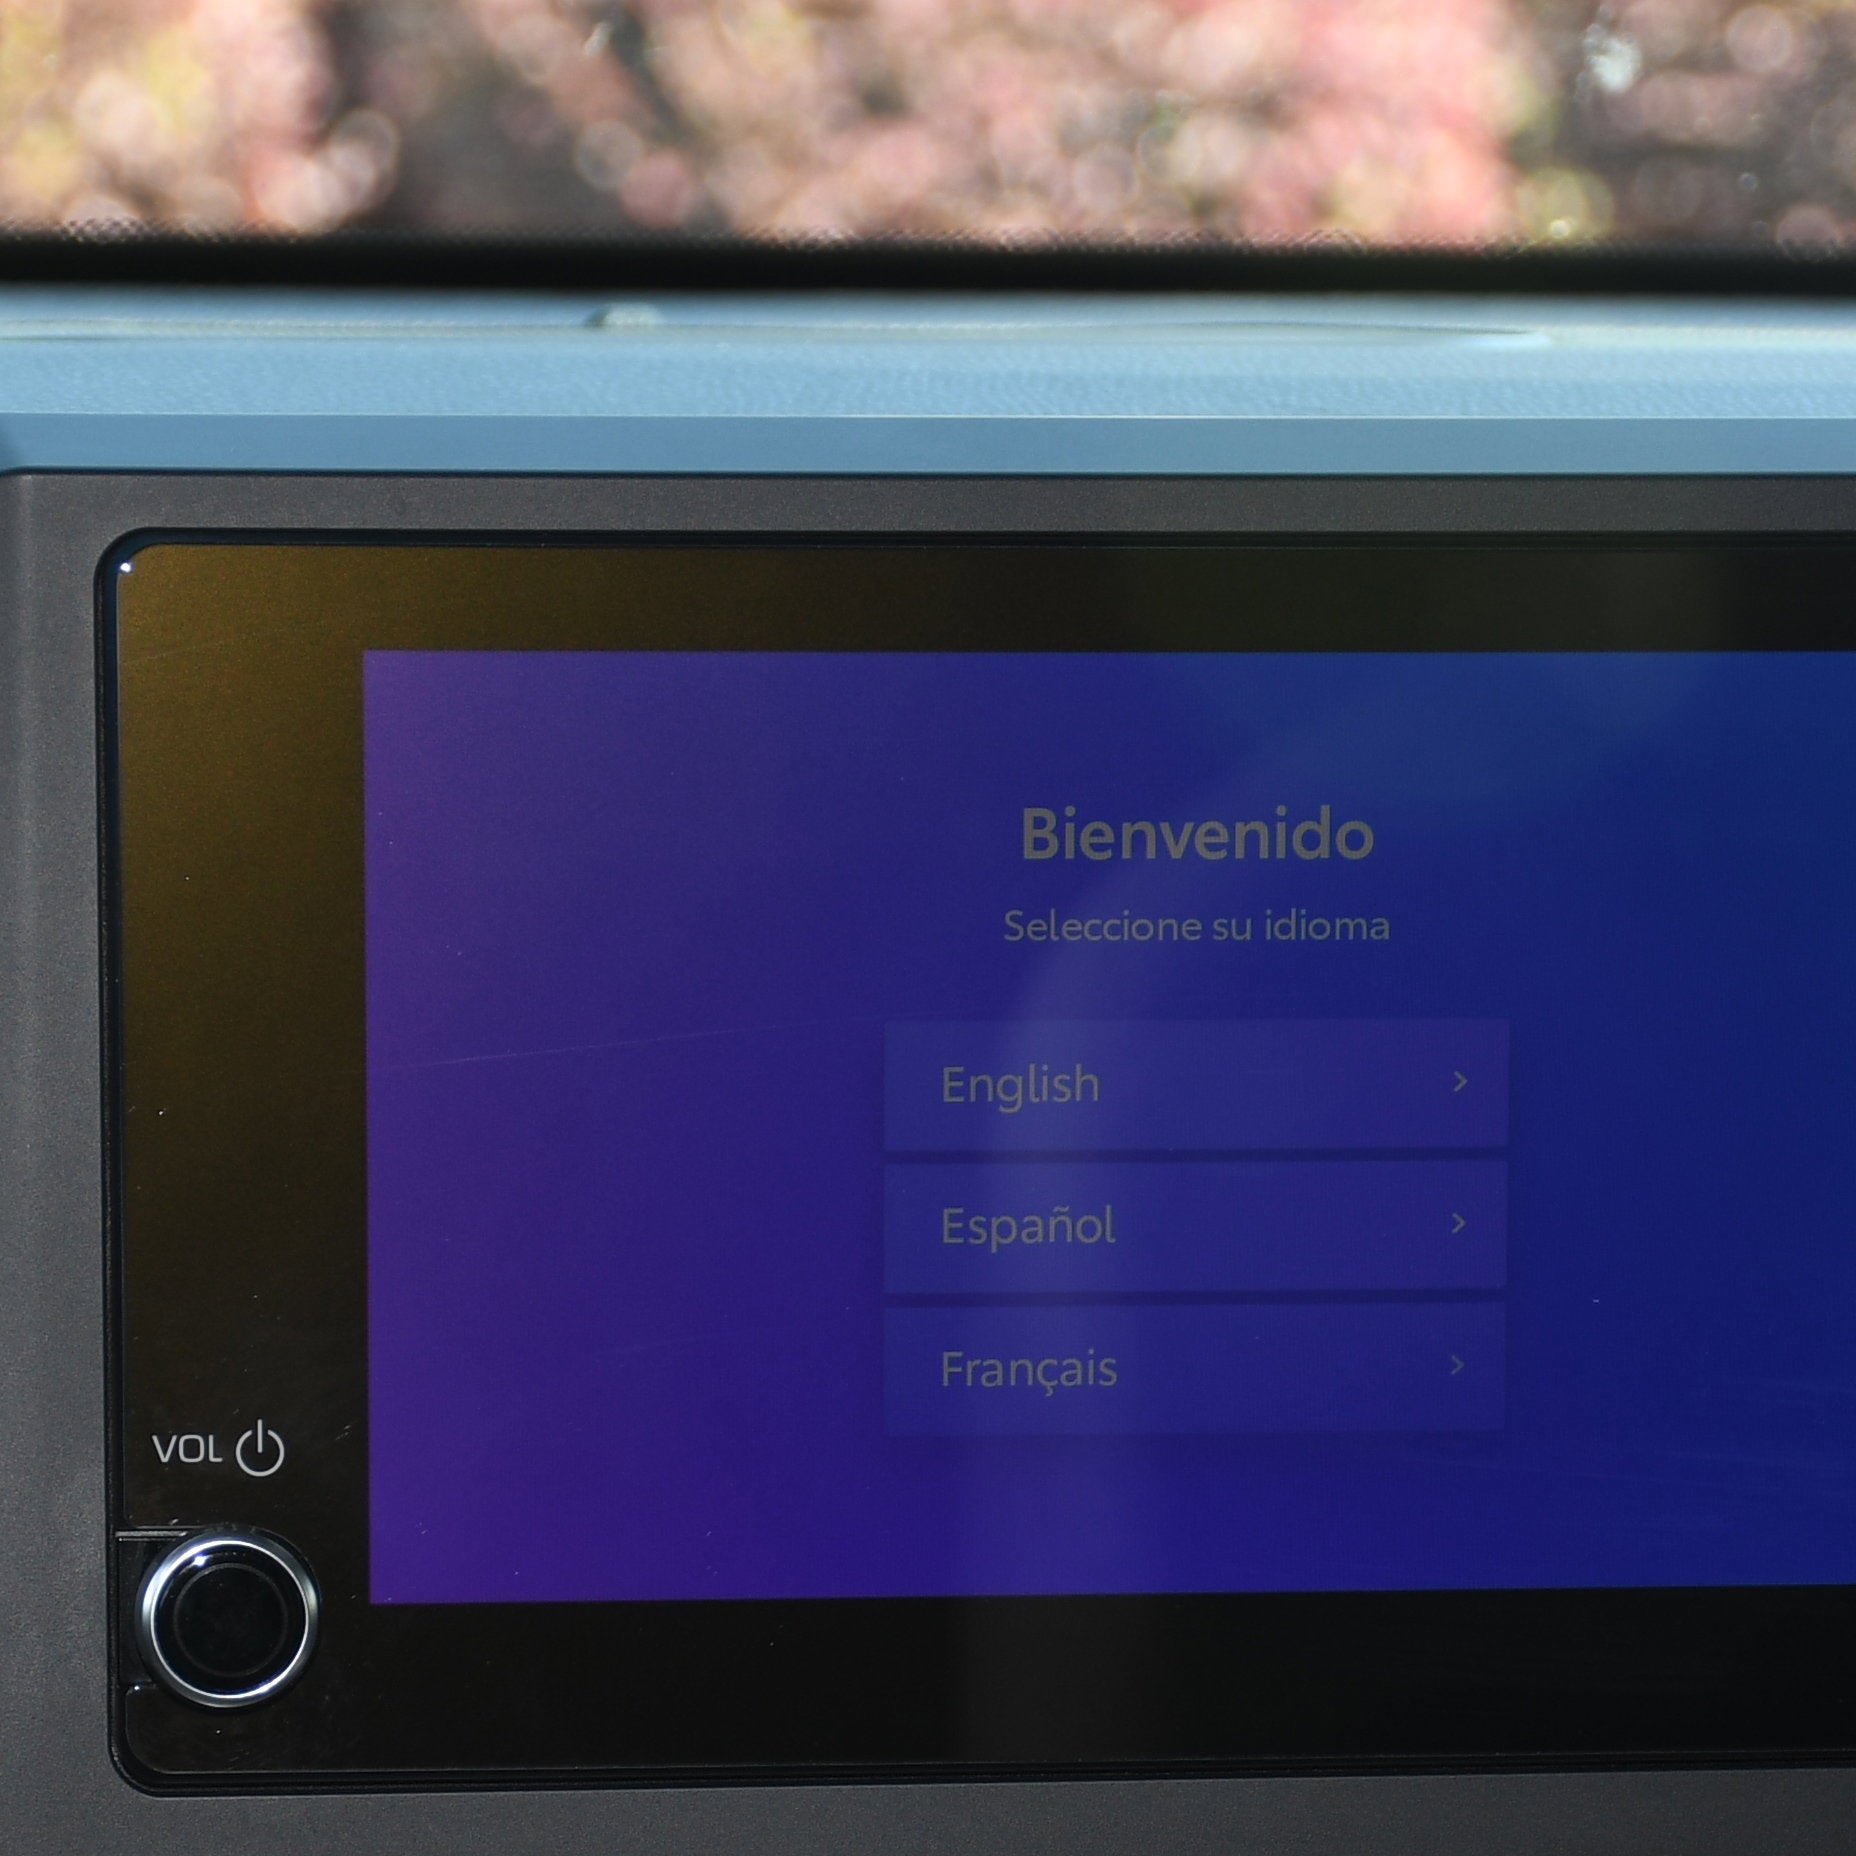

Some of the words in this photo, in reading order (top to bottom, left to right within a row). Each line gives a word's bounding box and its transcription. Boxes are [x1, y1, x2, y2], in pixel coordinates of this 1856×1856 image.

[1021, 804, 1375, 861] Bienvenido
[1003, 908, 1203, 942] Seleccione
[1212, 917, 1253, 942] su
[1265, 907, 1391, 942] idioma
[941, 1063, 1100, 1114] English
[941, 1204, 1117, 1254] Español
[941, 1348, 1119, 1397] Français
[151, 1434, 224, 1464] VOL
